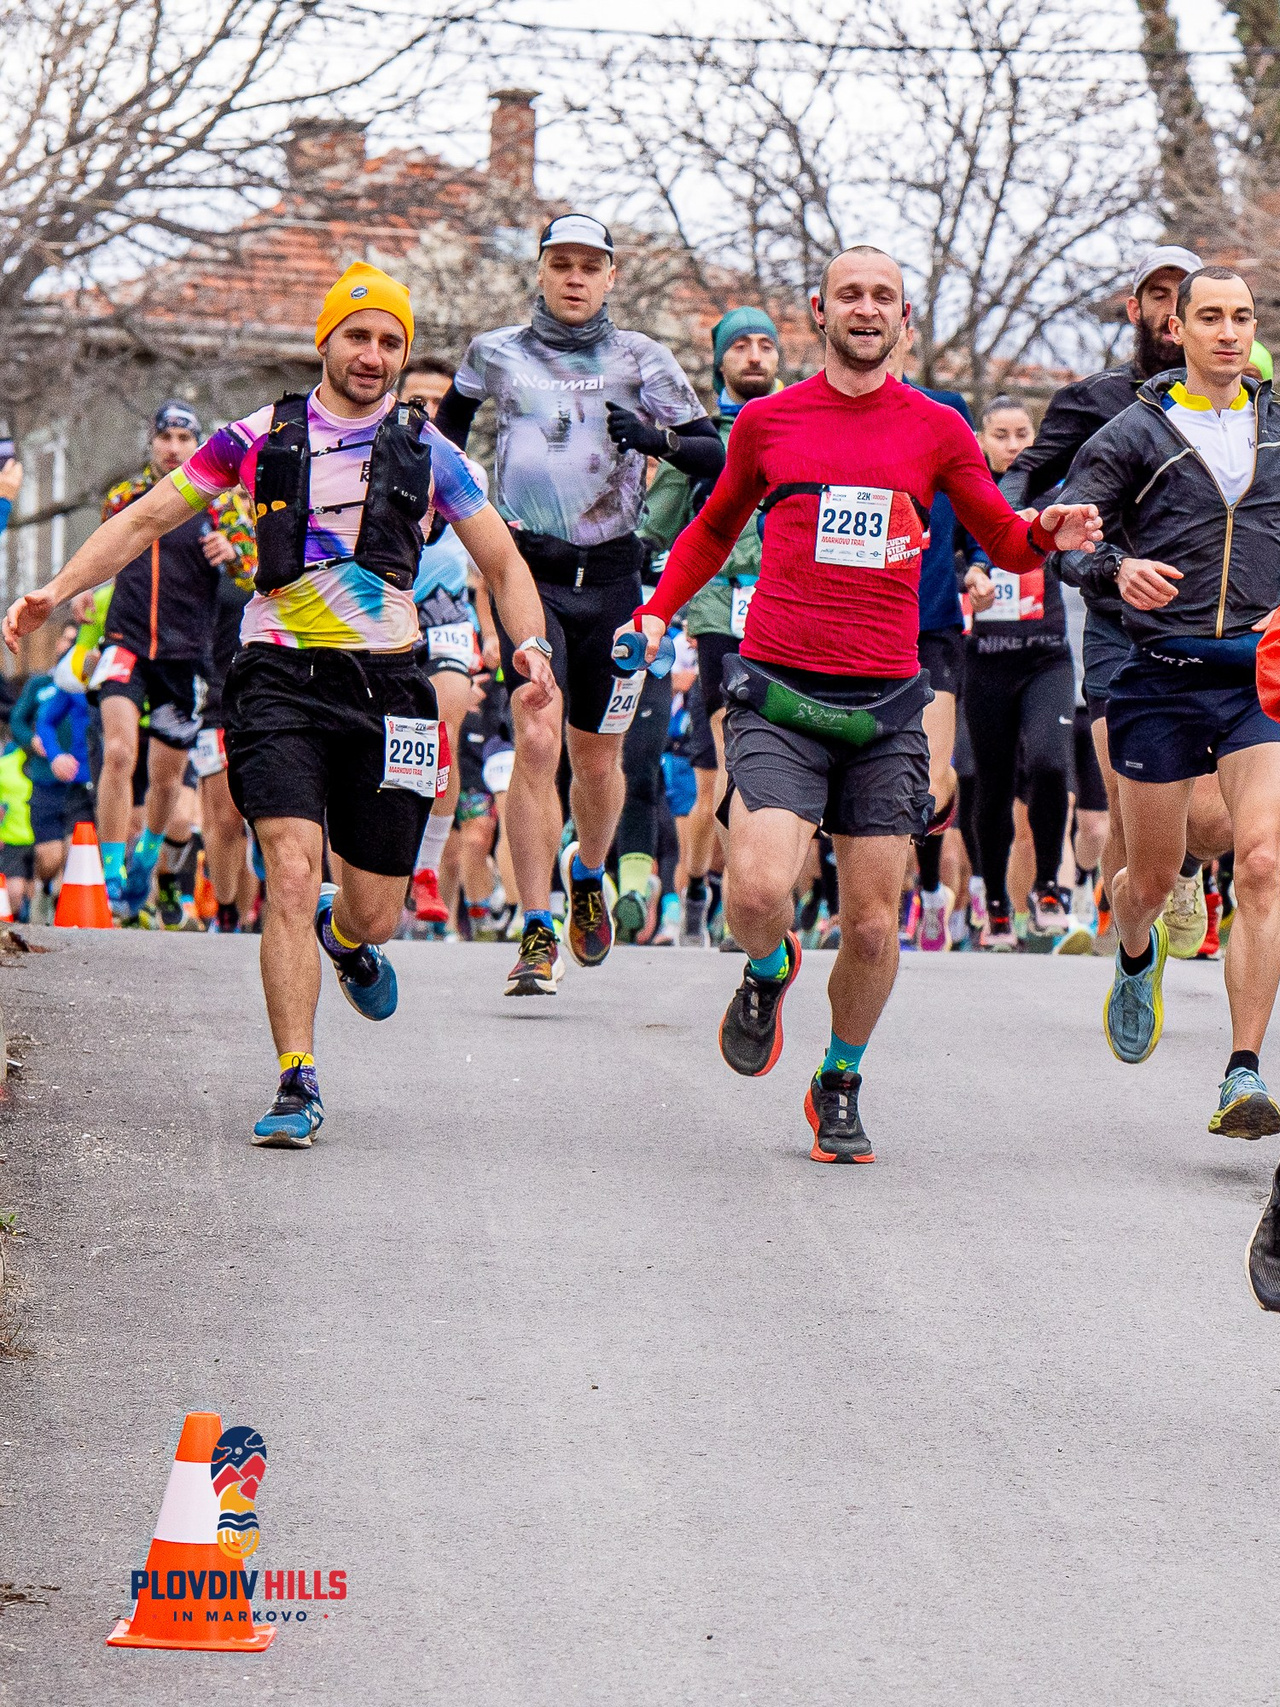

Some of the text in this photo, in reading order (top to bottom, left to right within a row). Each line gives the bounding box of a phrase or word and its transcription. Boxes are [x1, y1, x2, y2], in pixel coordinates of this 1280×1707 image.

[821, 508, 883, 538] 2283
[821, 535, 866, 547] MARKOVO TRAIL
[434, 630, 468, 648] 2163
[978, 636, 1023, 654] NIKE
[389, 738, 435, 767] 2295
